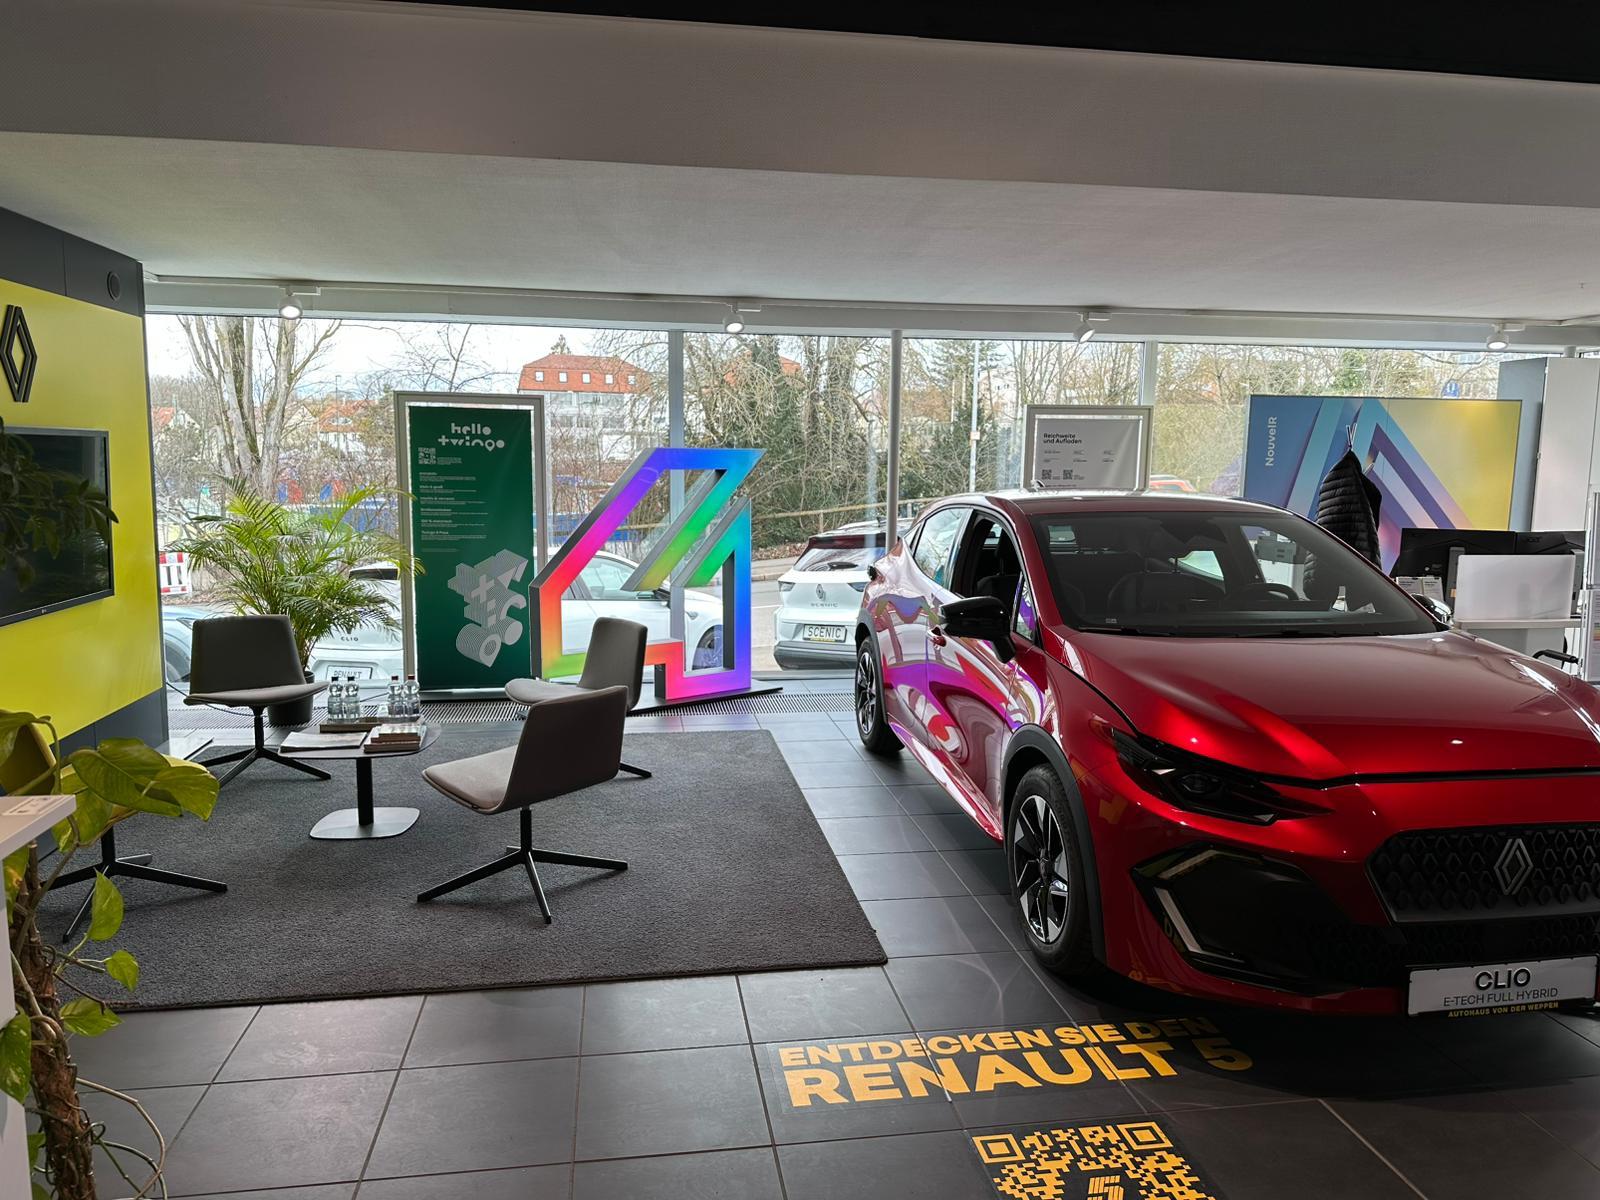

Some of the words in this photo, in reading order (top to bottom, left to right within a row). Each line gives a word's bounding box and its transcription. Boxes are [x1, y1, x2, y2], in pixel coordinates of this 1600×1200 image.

[450, 422, 492, 436] hello
[437, 435, 505, 452] twingo
[808, 626, 841, 638] SCENIC
[1475, 967, 1531, 990] CLIO
[1443, 995, 1485, 1007] E-TECH
[1487, 992, 1514, 1003] FULL
[1516, 987, 1558, 999] HYBRID
[1448, 1008, 1490, 1017] AUTOHAUS
[778, 1028, 1054, 1067] ENTDECKEN
[1054, 1023, 1127, 1045] SIE
[1123, 1017, 1220, 1040] DEN
[783, 1041, 1178, 1108] RENAULT
[1191, 1037, 1253, 1071] 5
